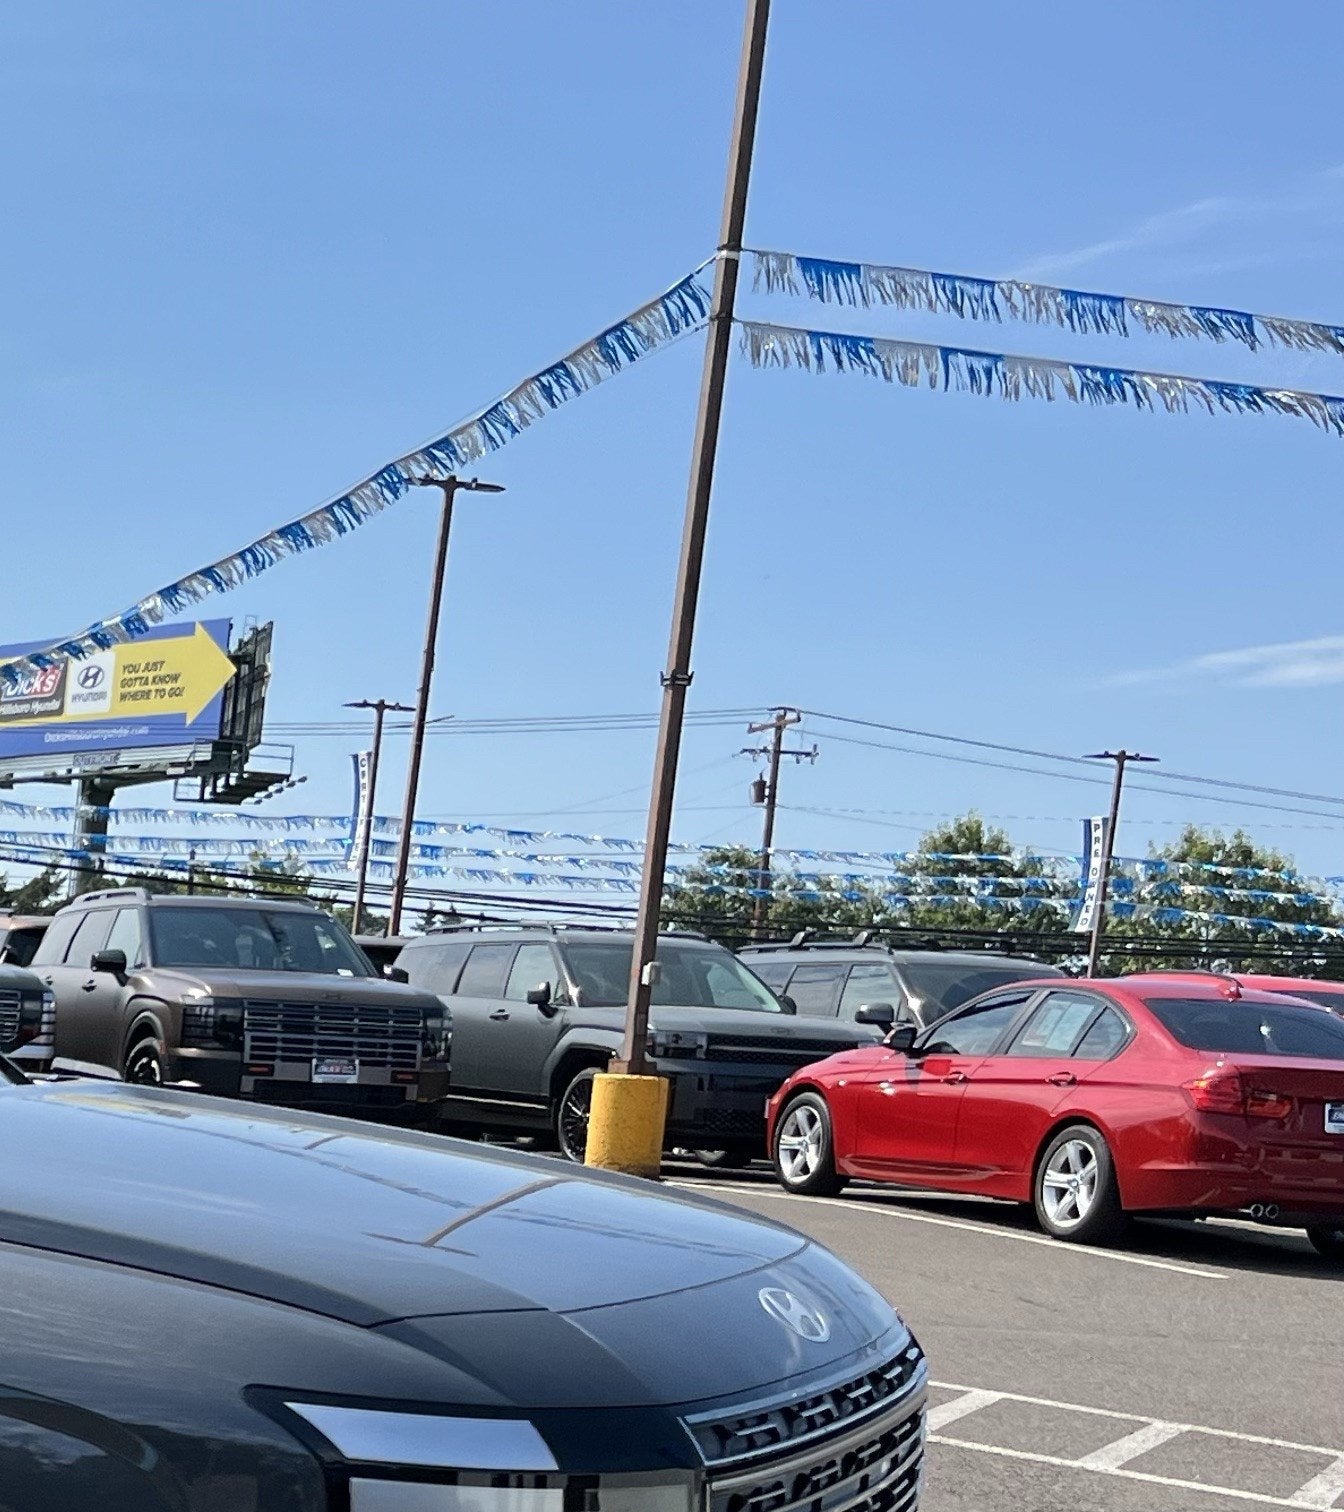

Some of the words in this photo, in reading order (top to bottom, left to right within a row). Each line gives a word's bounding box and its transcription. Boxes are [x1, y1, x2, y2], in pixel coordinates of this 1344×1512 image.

[122, 663, 141, 675] YOU
[142, 661, 166, 673] JUST
[120, 676, 149, 688] GOTTA
[151, 673, 181, 686] KNOW
[119, 689, 152, 702] WHERE
[153, 688, 166, 699] TO
